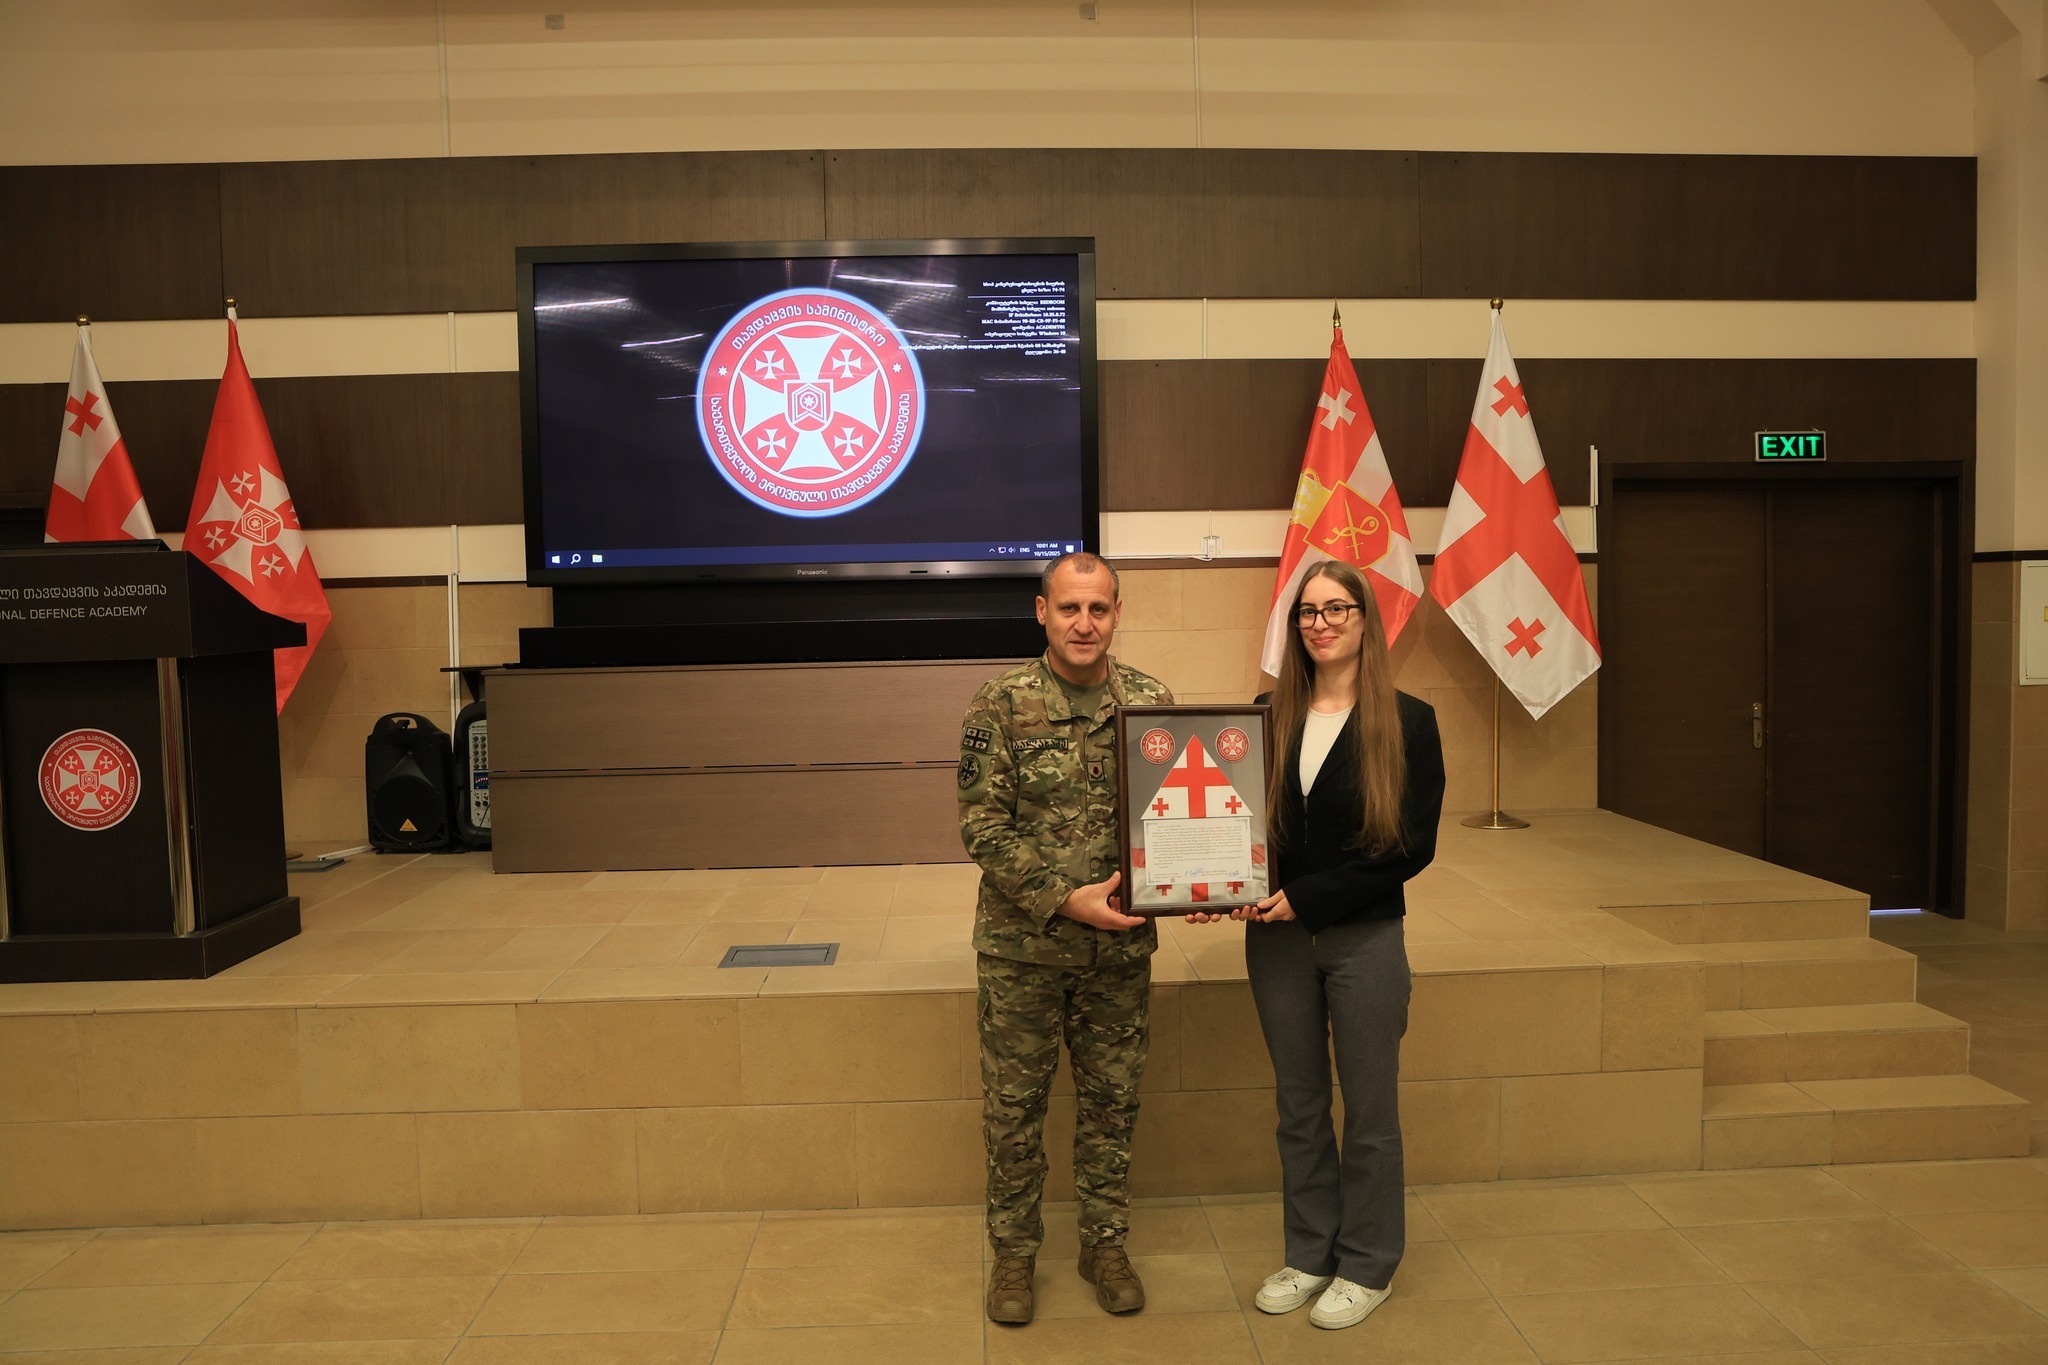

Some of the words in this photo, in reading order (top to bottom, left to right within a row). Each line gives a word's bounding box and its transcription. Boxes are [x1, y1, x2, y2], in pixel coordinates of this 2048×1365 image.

[731, 304, 802, 350] თავდაცვის
[806, 303, 887, 347] სამინისტრო
[710, 397, 757, 483] საქართველოს
[758, 478, 828, 502] ეროვნული
[830, 455, 892, 500] თავდაცვის
[888, 393, 910, 454] აკადემია
[1762, 436, 1821, 457] EXIT
[24, 586, 99, 599] თავდაცვის
[104, 584, 167, 597] აკადემია
[0, 610, 26, 620] NAL
[30, 608, 85, 619] DEFENCE
[89, 606, 148, 617] ACADEMY
